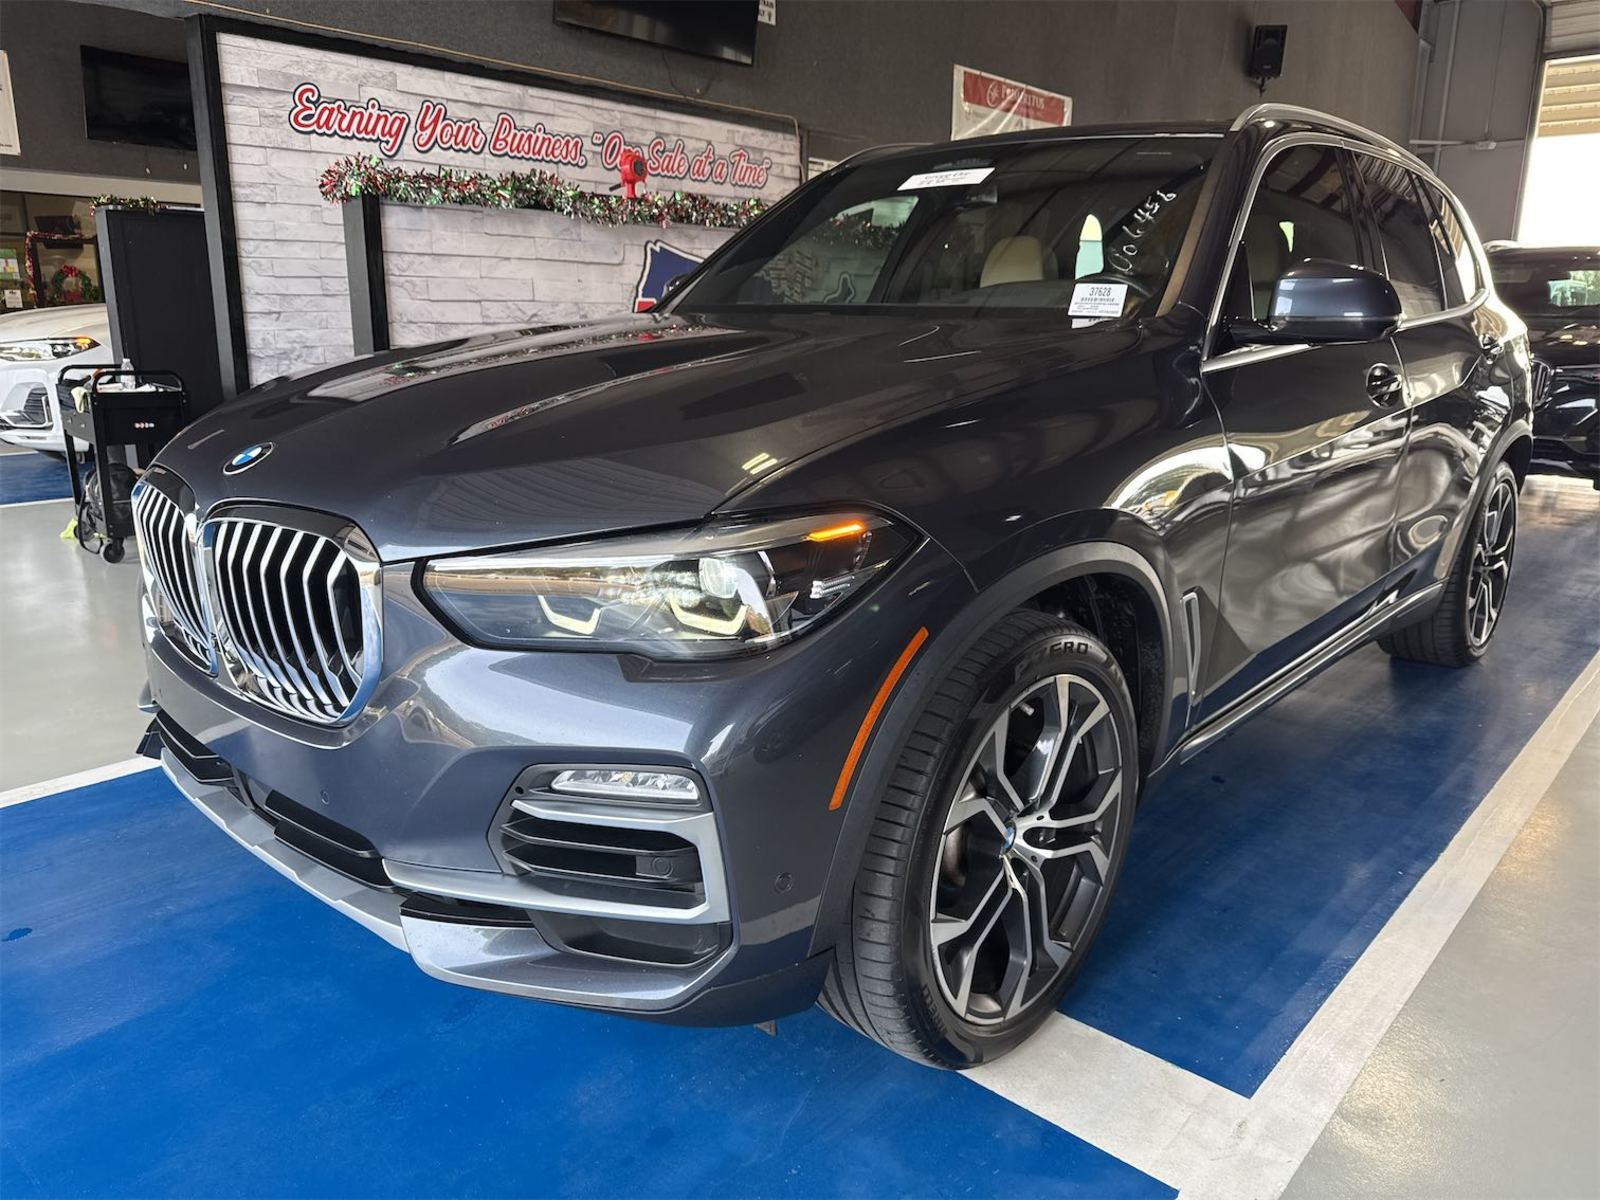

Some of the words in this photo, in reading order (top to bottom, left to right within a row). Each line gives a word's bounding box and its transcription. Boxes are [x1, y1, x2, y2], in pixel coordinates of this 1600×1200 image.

[290, 84, 409, 156] Earning
[415, 101, 486, 153] Your
[647, 139, 689, 177] Sale
[690, 144, 713, 182] at
[712, 160, 729, 184] a
